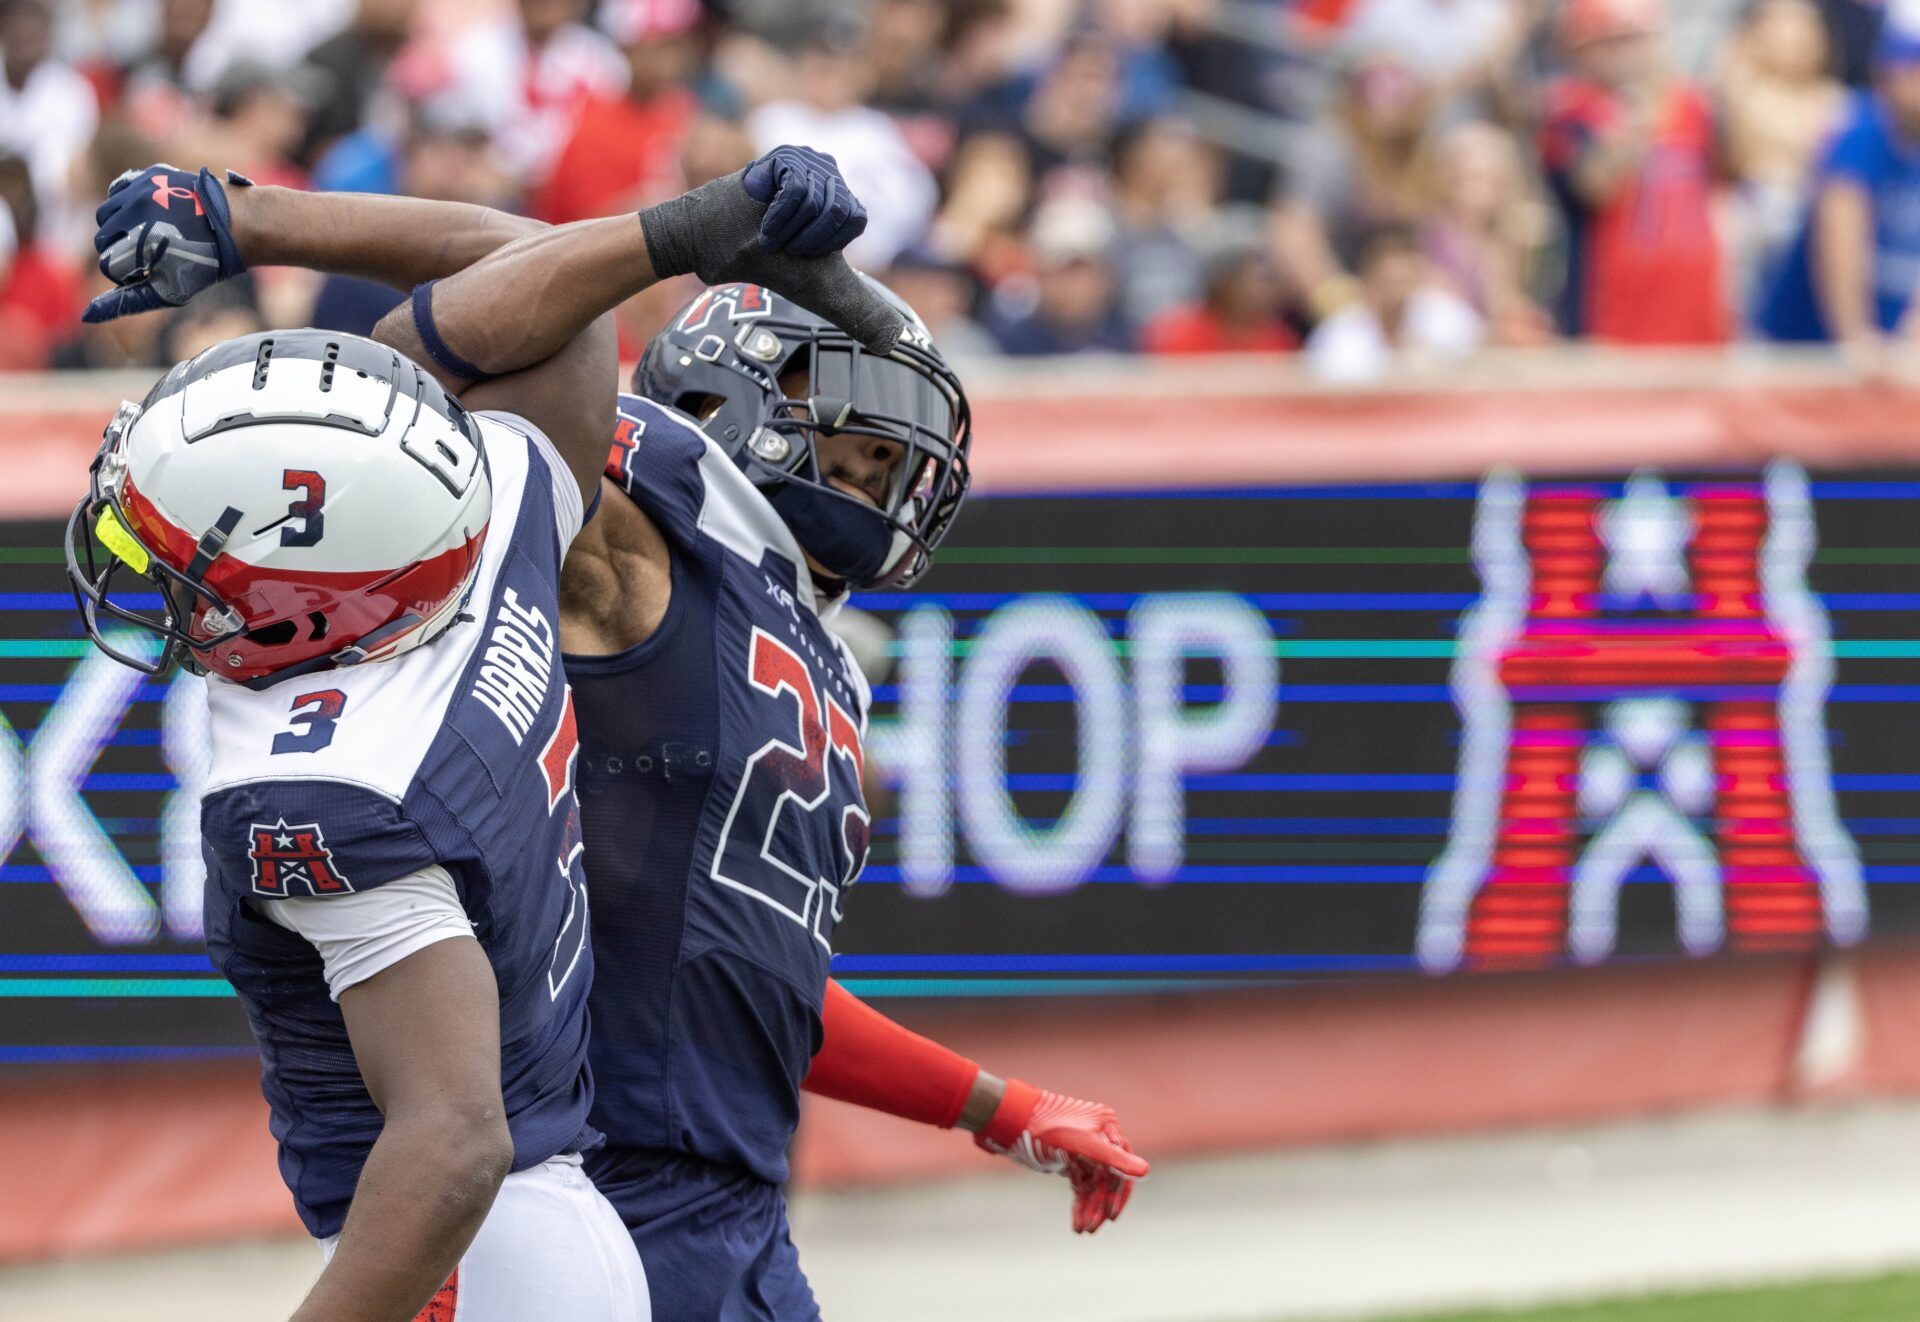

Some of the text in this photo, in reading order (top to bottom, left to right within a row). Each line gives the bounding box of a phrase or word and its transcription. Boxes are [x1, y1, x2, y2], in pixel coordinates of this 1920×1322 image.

[280, 468, 326, 547] 3
[471, 586, 554, 745] HARRIS
[270, 688, 348, 755] 3
